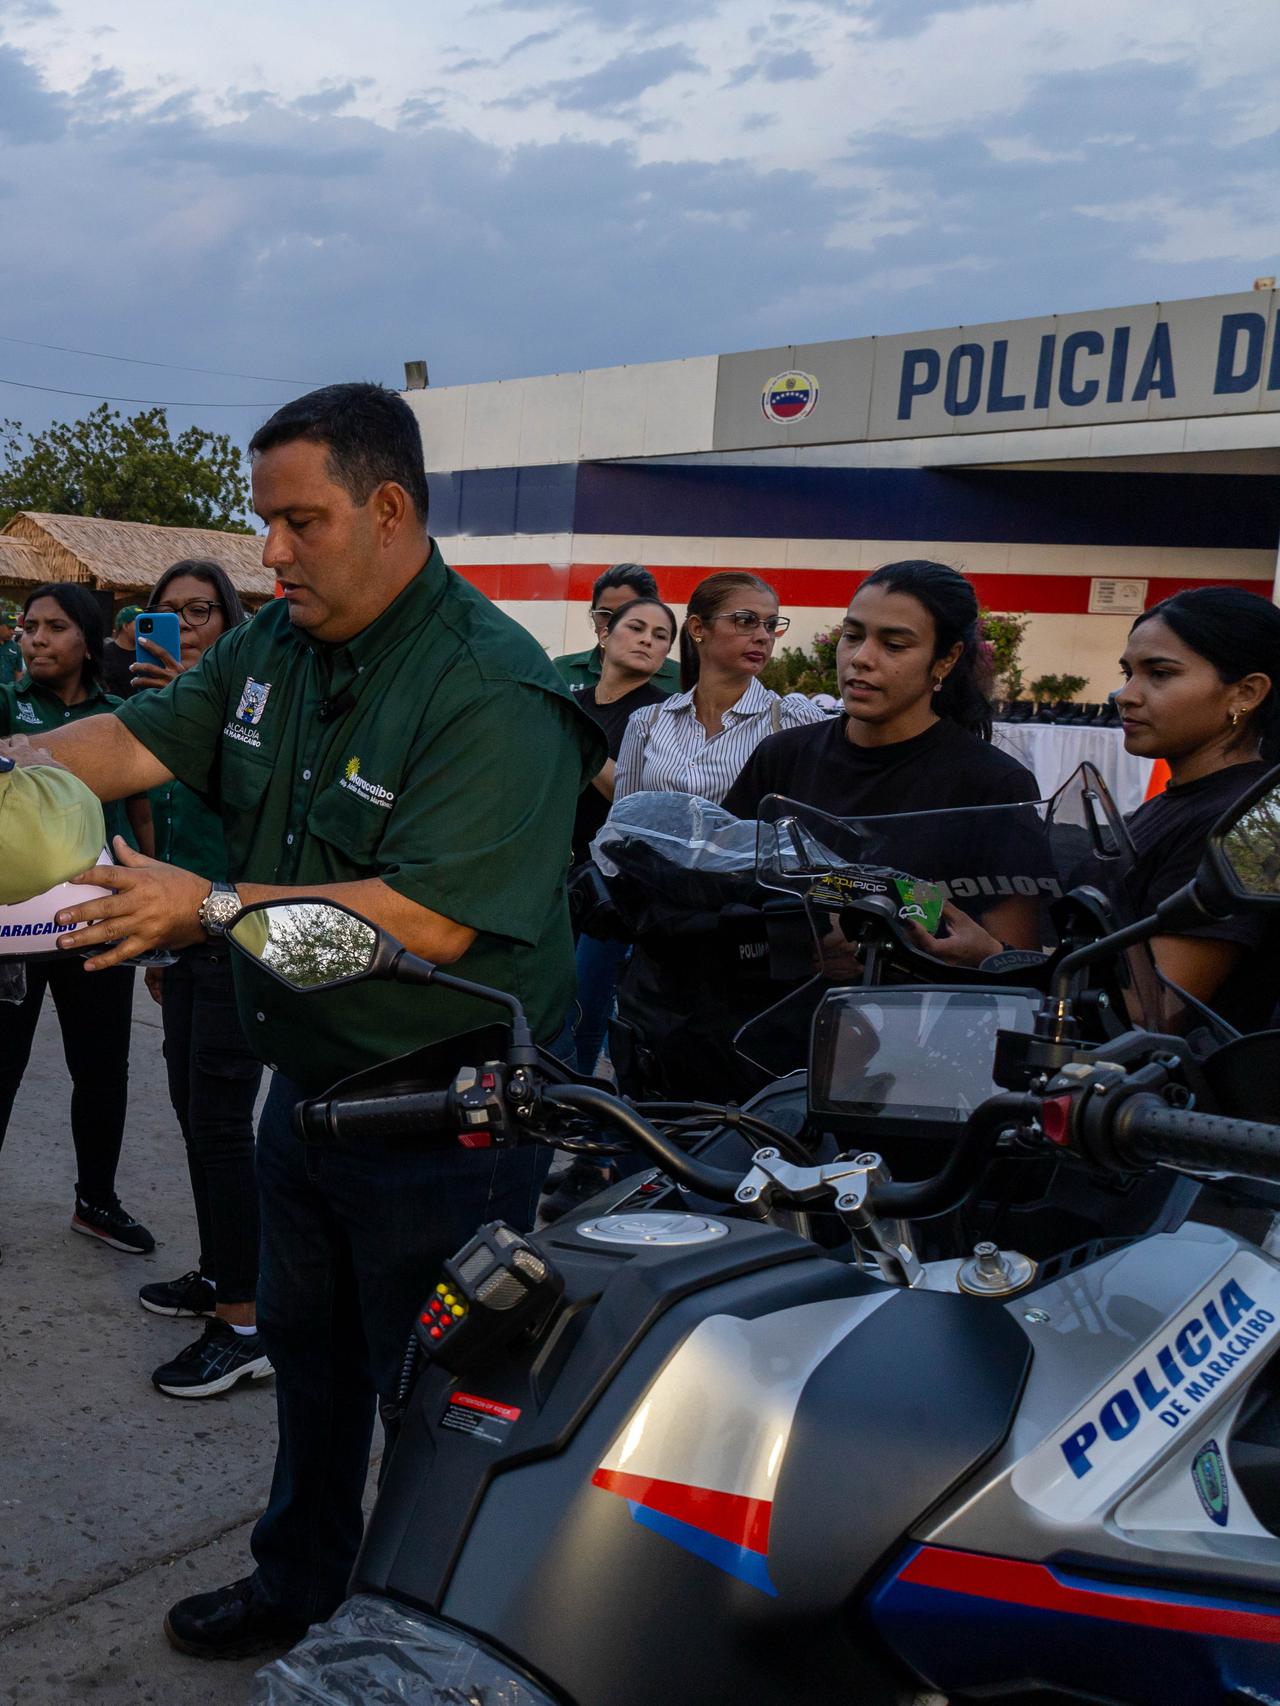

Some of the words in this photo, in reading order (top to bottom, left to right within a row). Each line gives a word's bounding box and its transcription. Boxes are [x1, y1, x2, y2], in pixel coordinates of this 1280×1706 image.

[897, 321, 1177, 420] POLICIA
[1213, 309, 1280, 396] D
[228, 730, 261, 748] MARACAIBO
[349, 771, 395, 801] Maracaibo
[1060, 1278, 1257, 1480] POLICIA
[1158, 1399, 1192, 1428] DE
[1183, 1309, 1276, 1403] MARACAIBO
